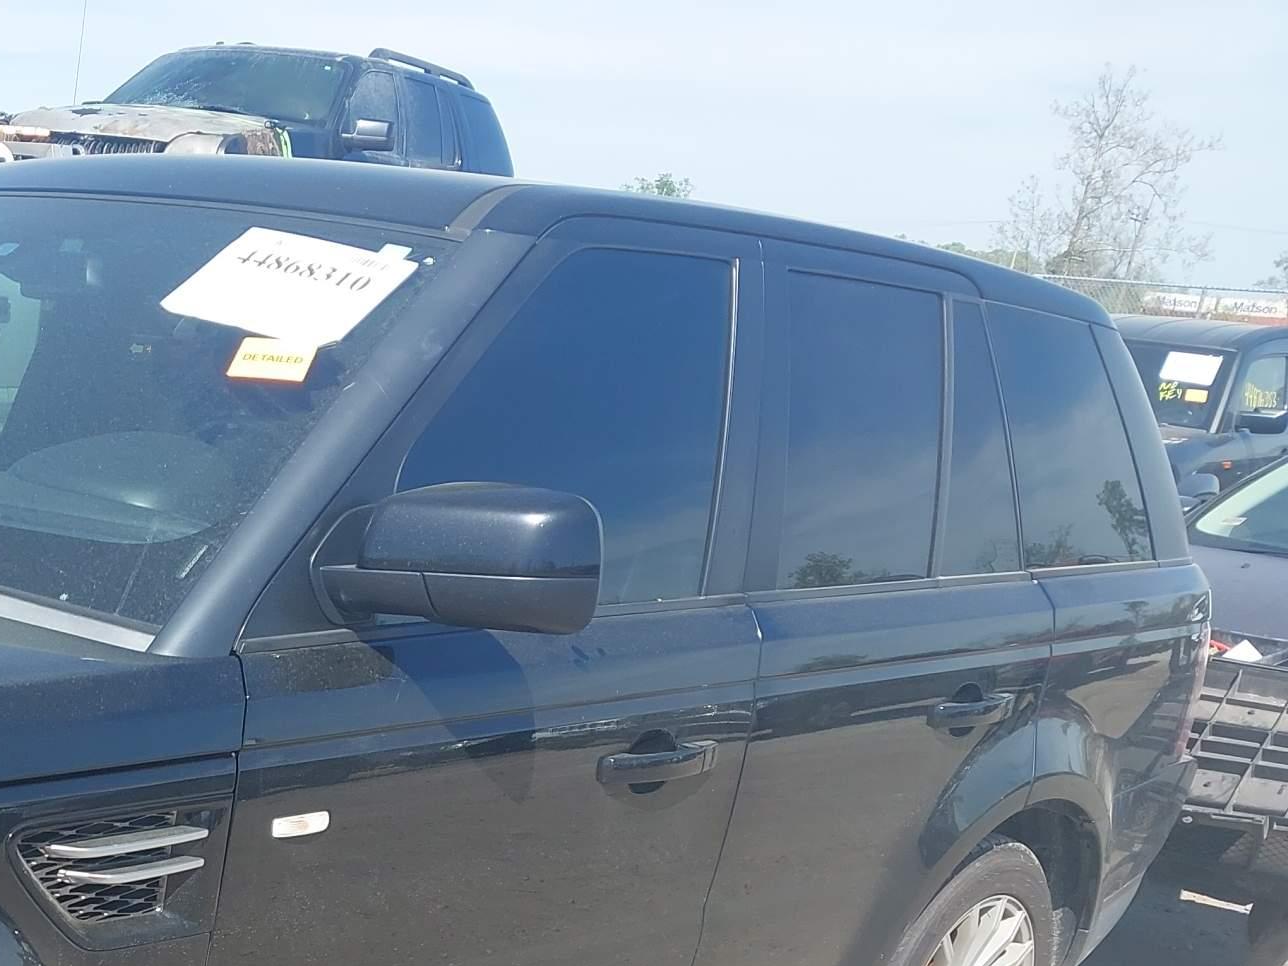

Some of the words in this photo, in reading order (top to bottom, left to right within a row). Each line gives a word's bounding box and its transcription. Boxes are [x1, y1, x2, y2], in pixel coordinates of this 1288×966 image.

[237, 250, 372, 292] 44868310
[1232, 301, 1278, 314] Matson
[241, 352, 304, 365] DETAILED
